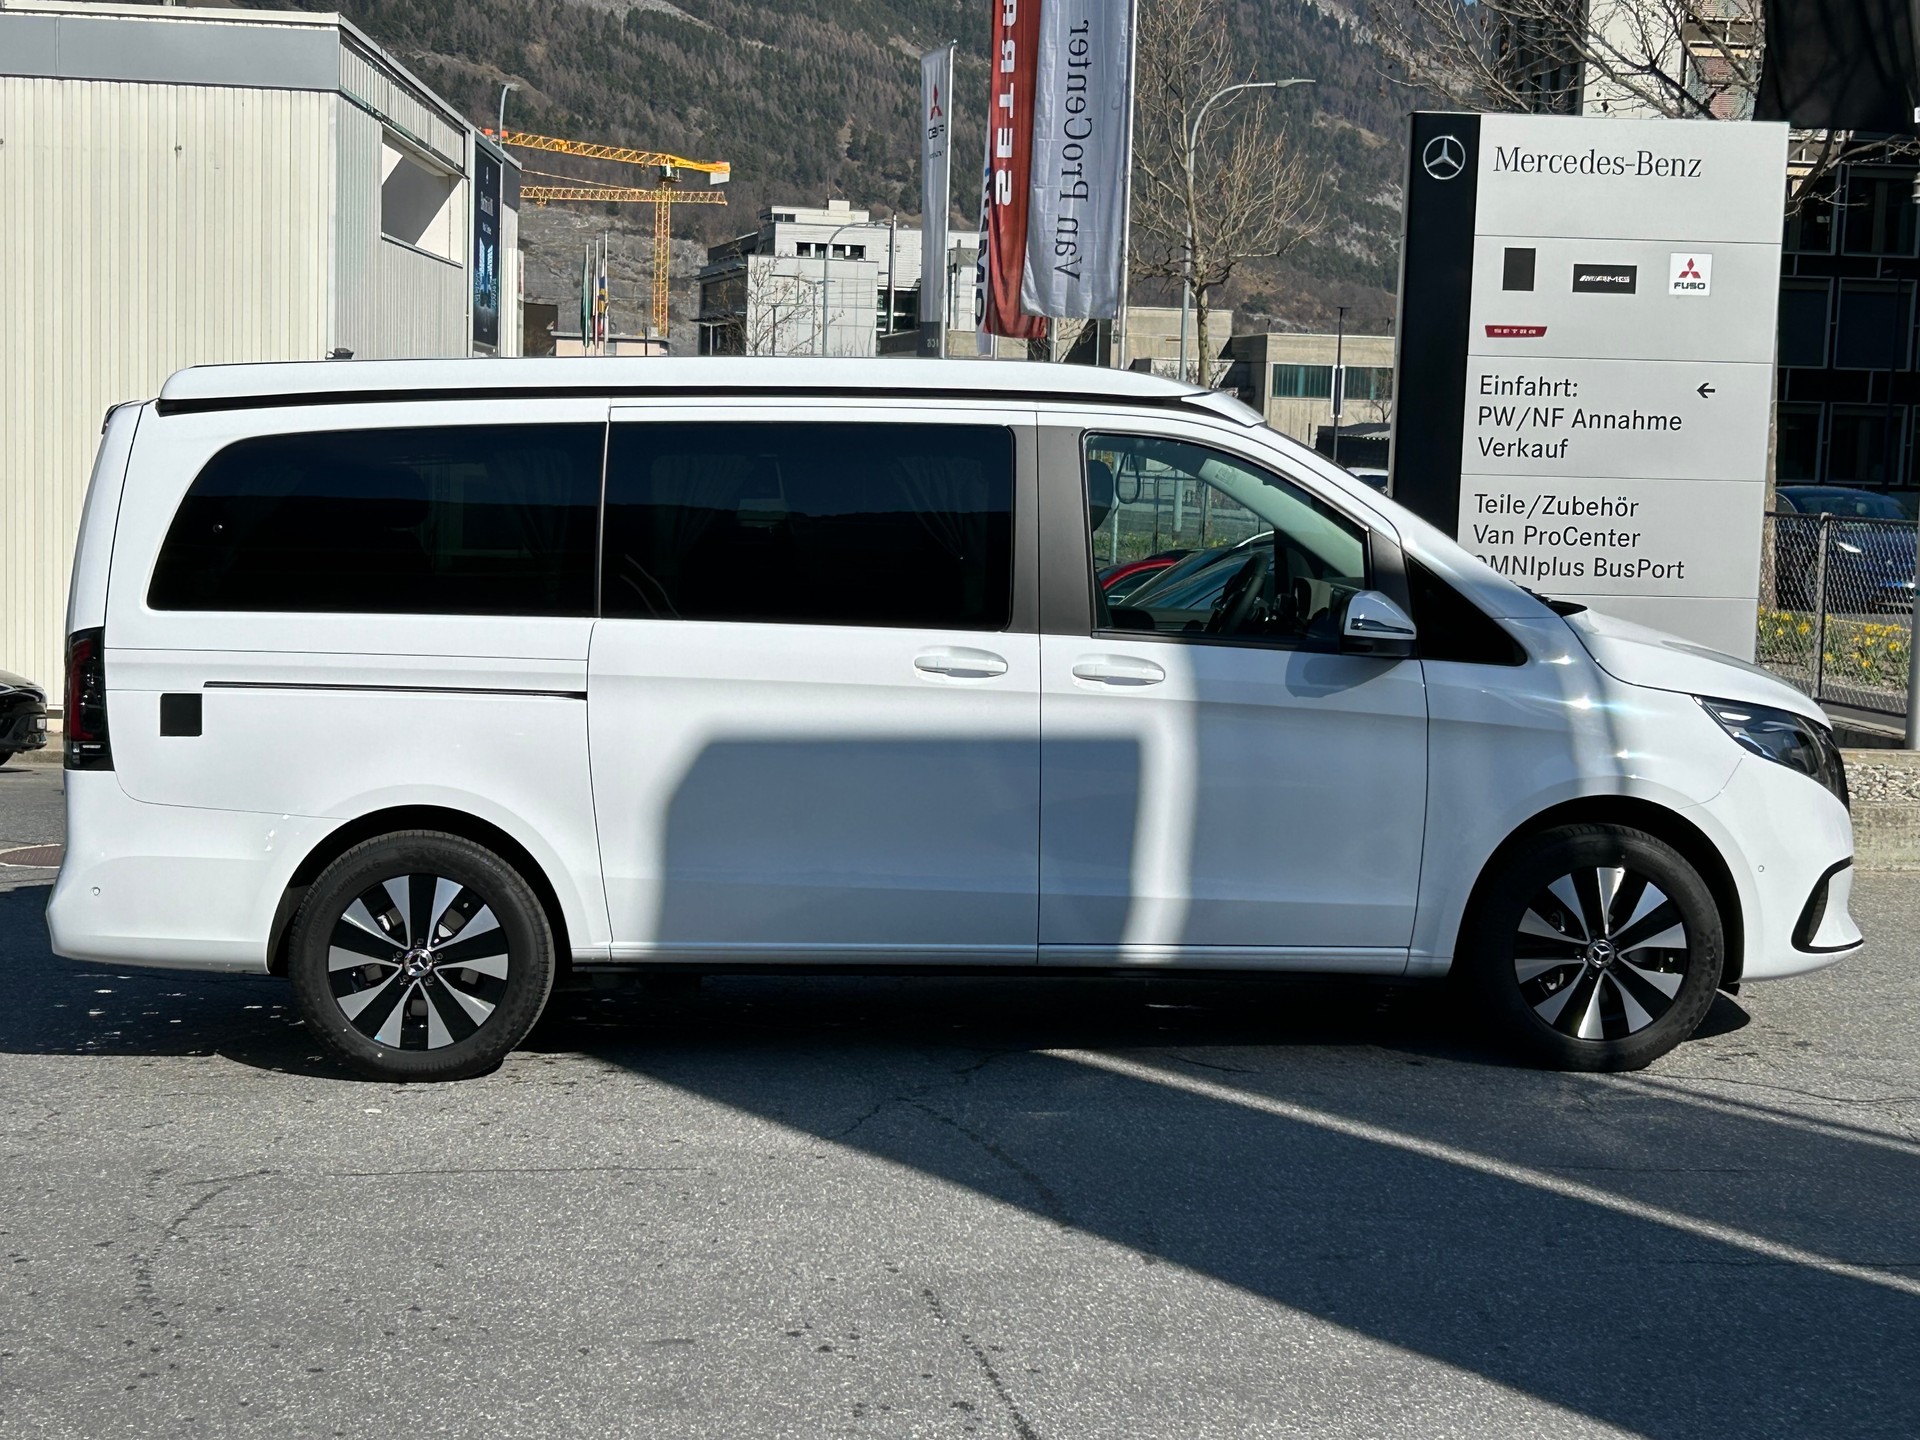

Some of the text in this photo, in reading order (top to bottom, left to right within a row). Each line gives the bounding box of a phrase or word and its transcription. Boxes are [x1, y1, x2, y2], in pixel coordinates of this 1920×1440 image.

[1493, 146, 1702, 178] Mercedes-Benz
[1673, 282, 1706, 290] FUSO
[1480, 374, 1578, 398] Einfahrt:
[1478, 405, 1682, 432] PW/NF Annahme
[1478, 436, 1569, 459] Verkauf
[1474, 493, 1639, 519] Teile/Zubehör
[1473, 524, 1641, 548] Van ProCenter
[1594, 557, 1685, 580] BusPort
